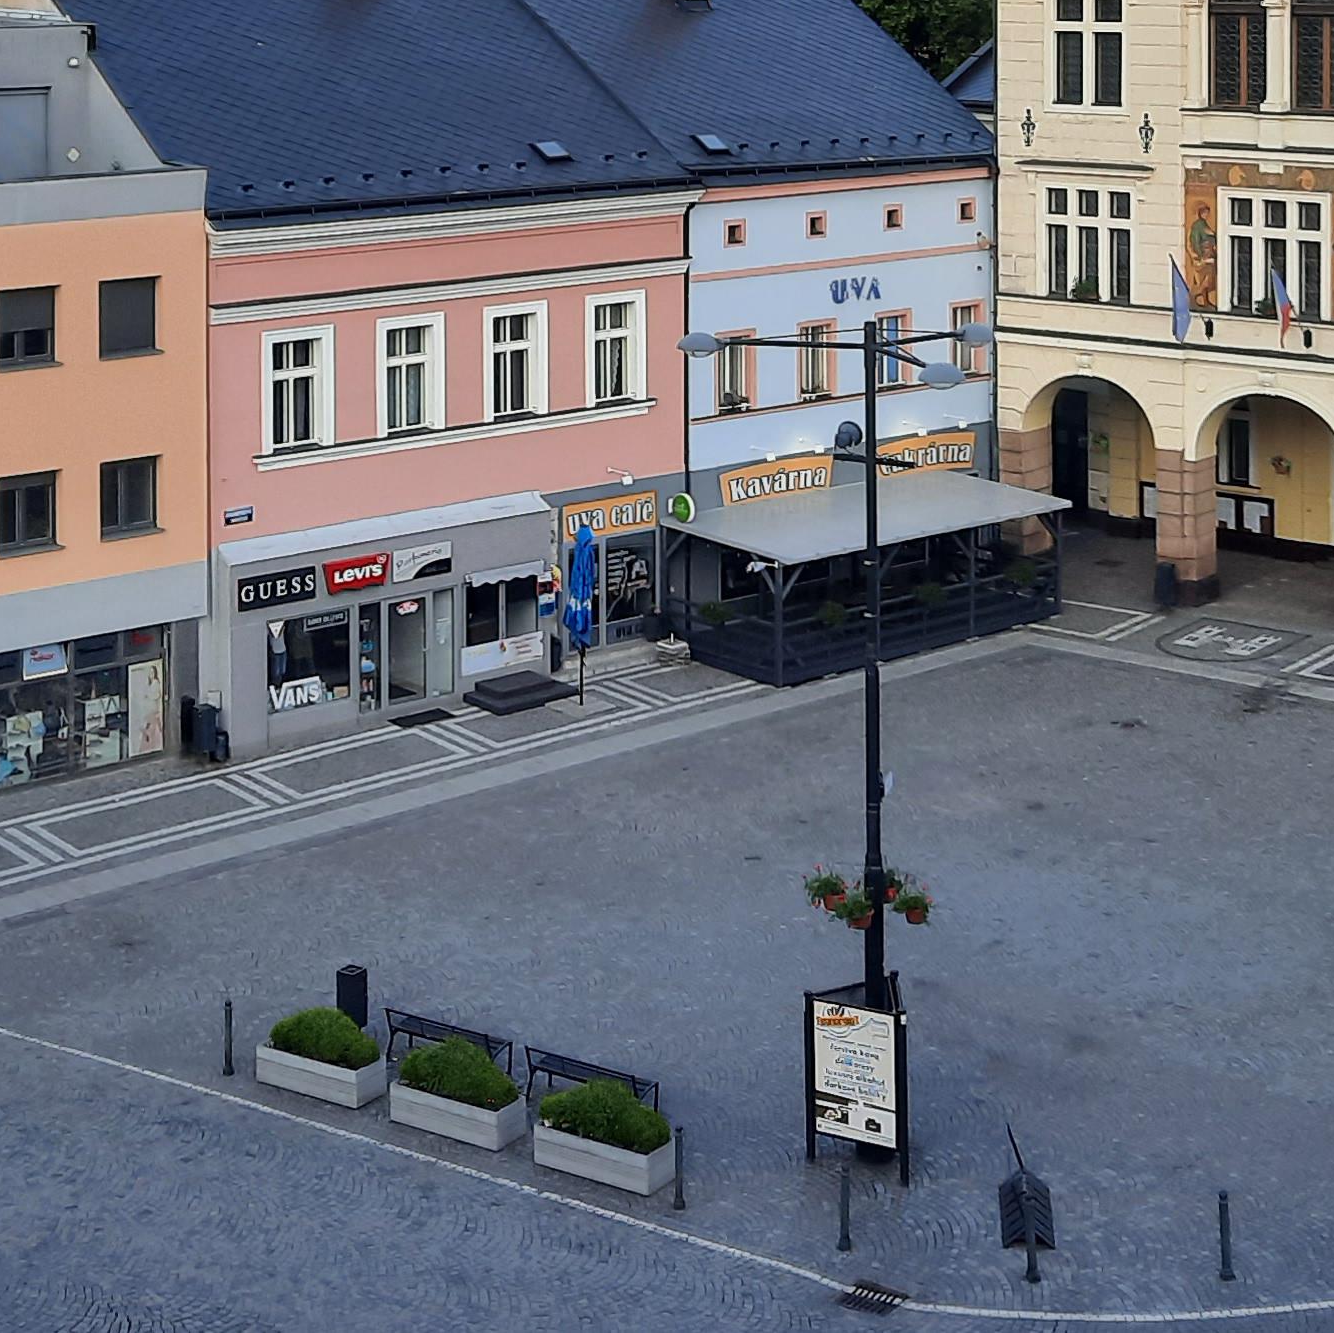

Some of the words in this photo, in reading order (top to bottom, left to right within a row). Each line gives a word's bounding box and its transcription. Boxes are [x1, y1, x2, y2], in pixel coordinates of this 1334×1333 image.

[829, 276, 881, 305] UVA
[729, 467, 827, 503] Kavárna
[567, 508, 605, 536] uva
[610, 497, 654, 528] café
[240, 574, 315, 603] GUESS
[269, 675, 321, 711] VANS
